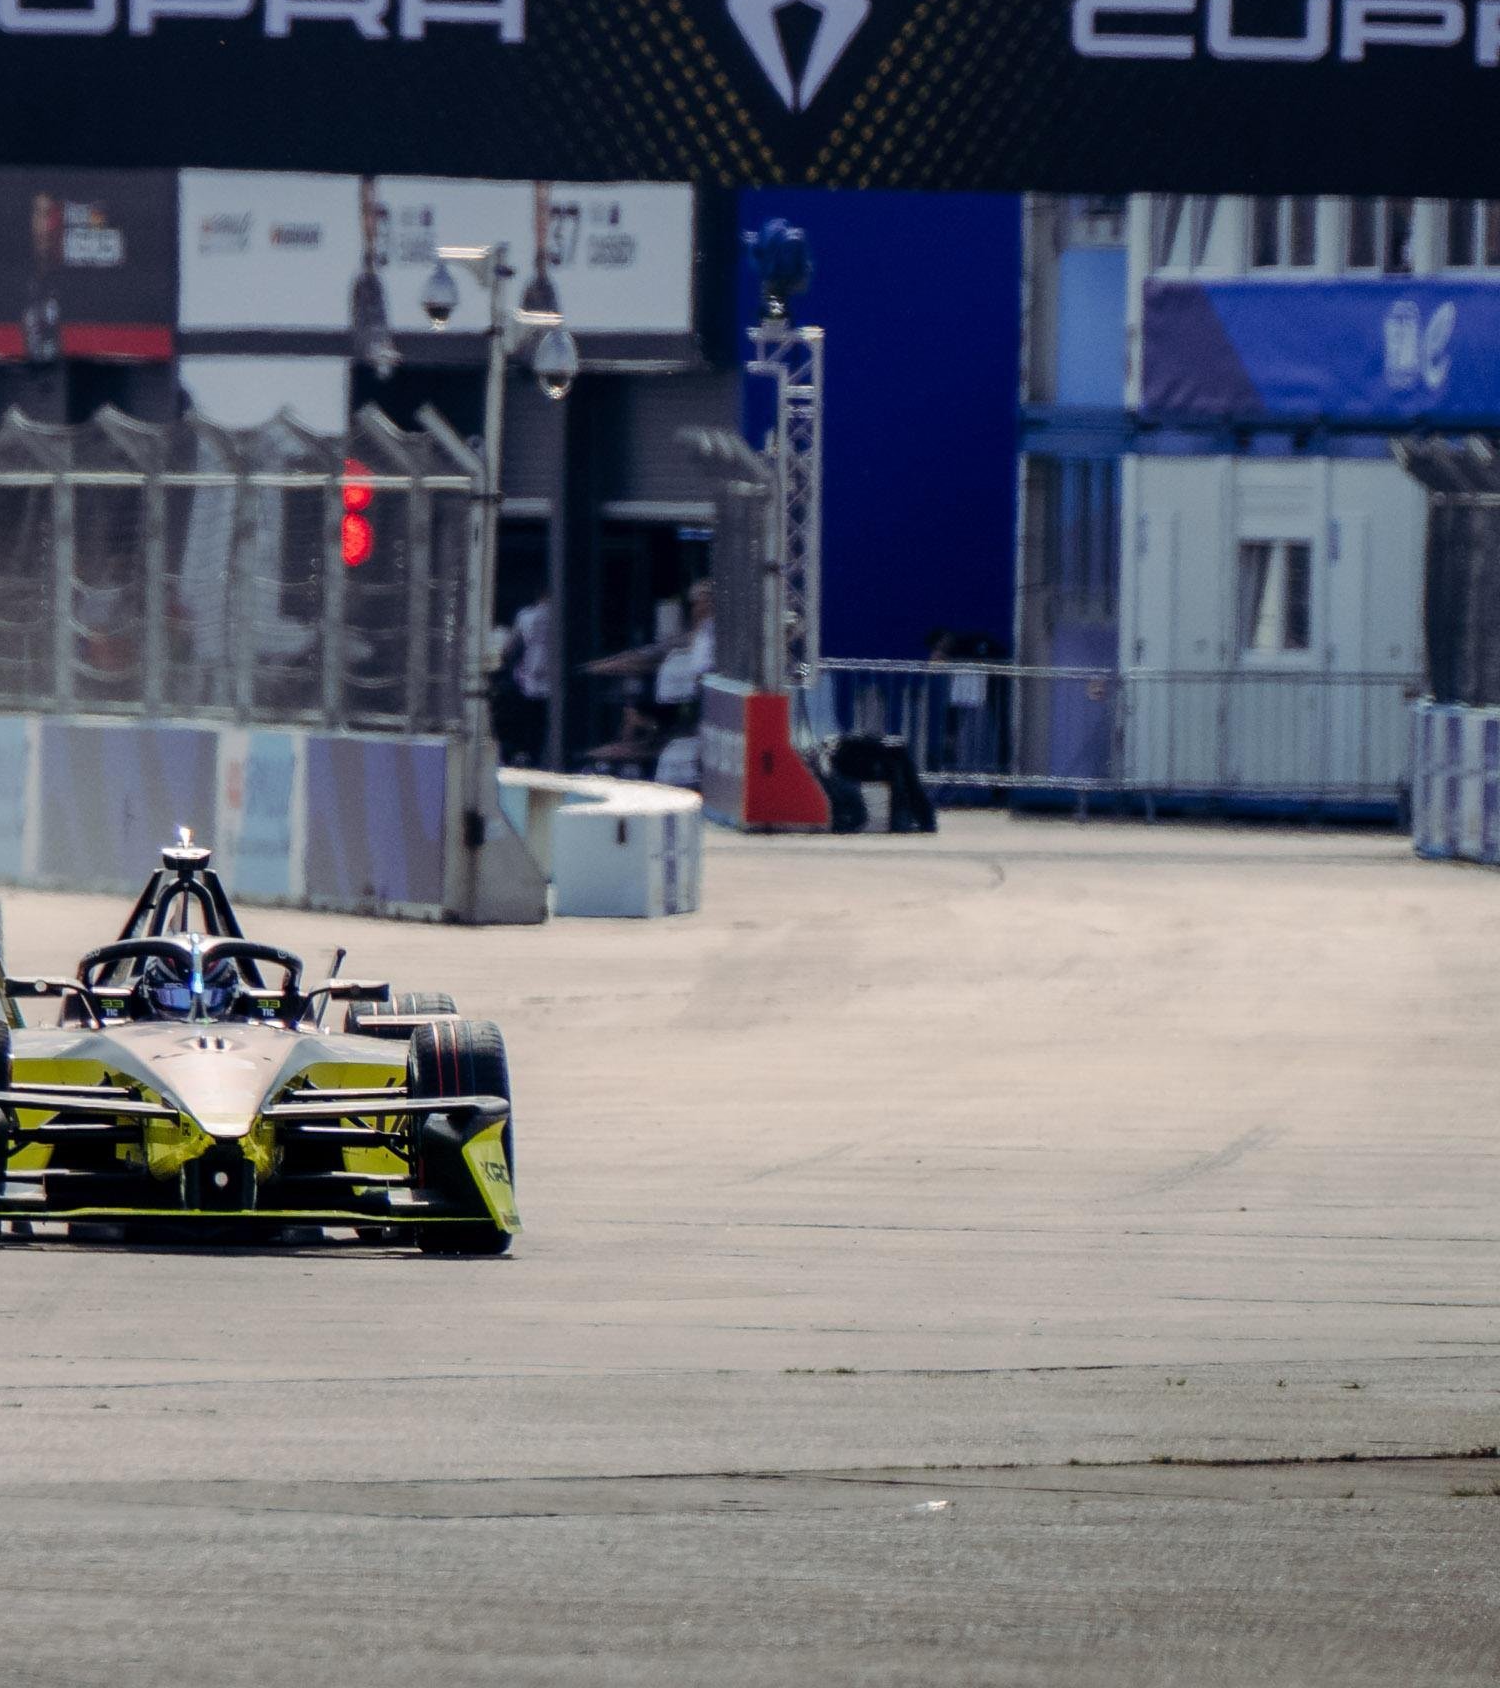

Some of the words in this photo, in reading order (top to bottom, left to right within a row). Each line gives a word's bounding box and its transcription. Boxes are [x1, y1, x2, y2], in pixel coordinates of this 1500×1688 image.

[101, 999, 124, 1009] 33
[257, 999, 281, 1009] 33
[106, 1009, 118, 1017] TIC
[262, 1009, 275, 1017] TIC
